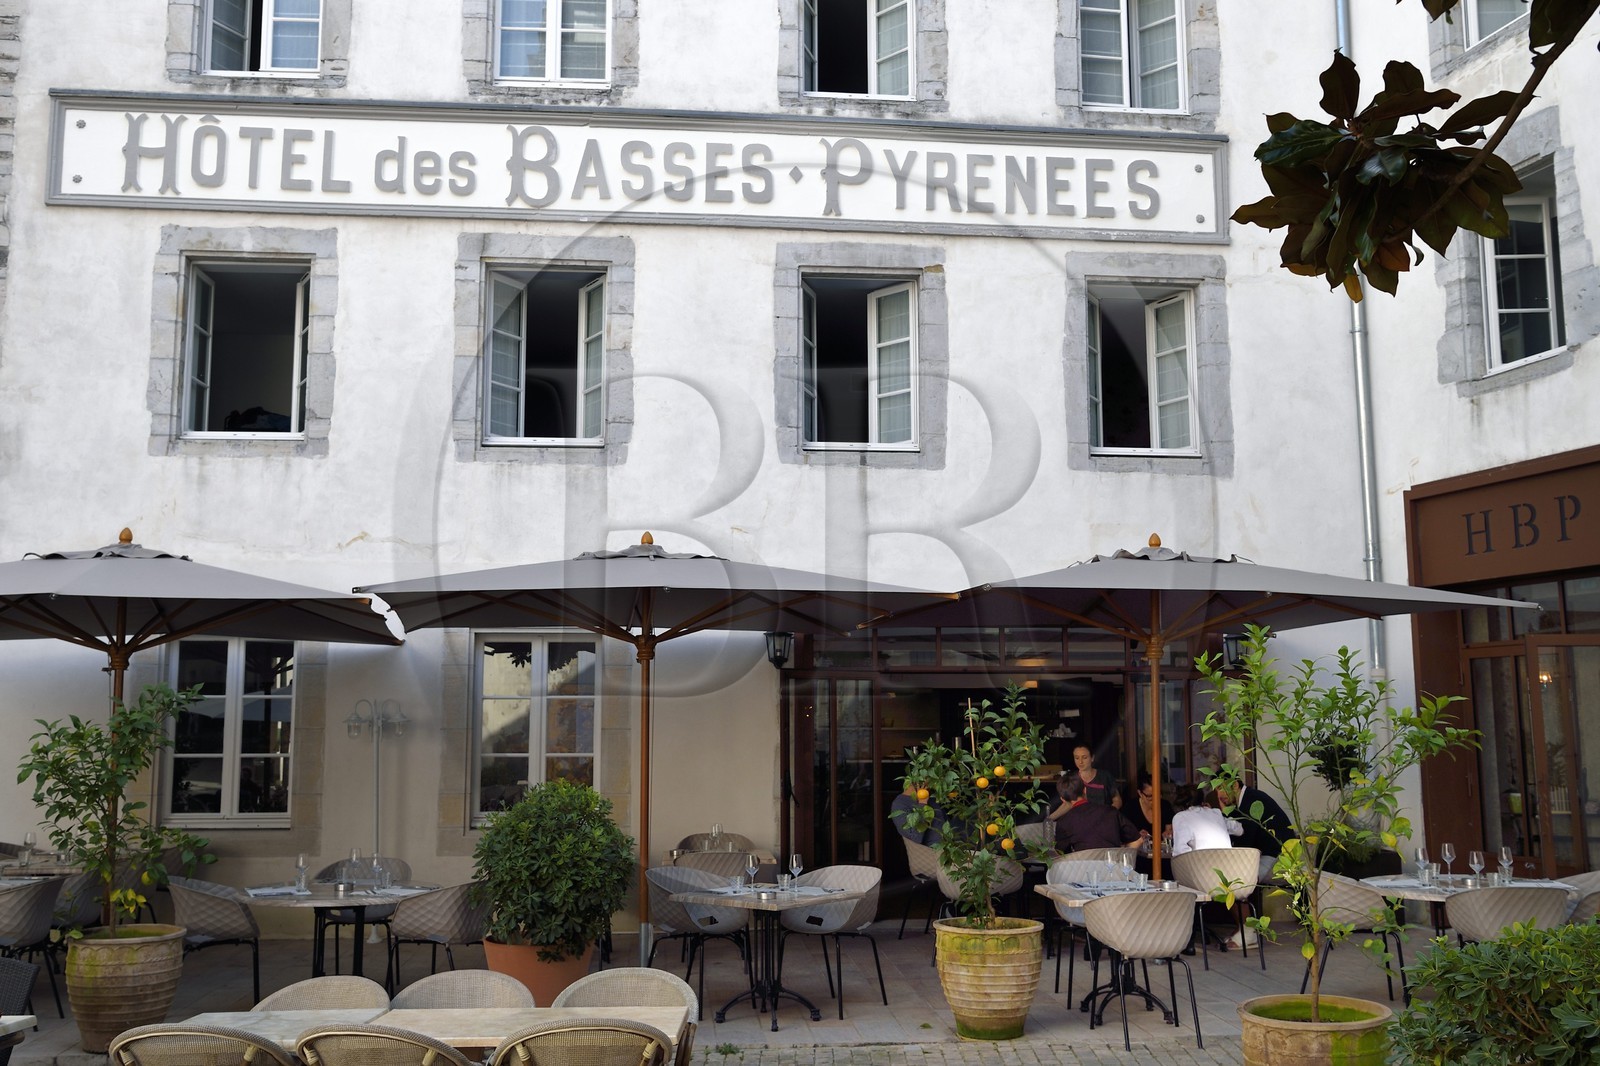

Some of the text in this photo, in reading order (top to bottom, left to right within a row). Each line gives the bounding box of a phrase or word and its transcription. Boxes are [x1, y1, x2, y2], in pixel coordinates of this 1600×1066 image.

[121, 112, 1161, 220] HÔTEL des BASSES PYRENEES
[1462, 495, 1581, 556] HBP
